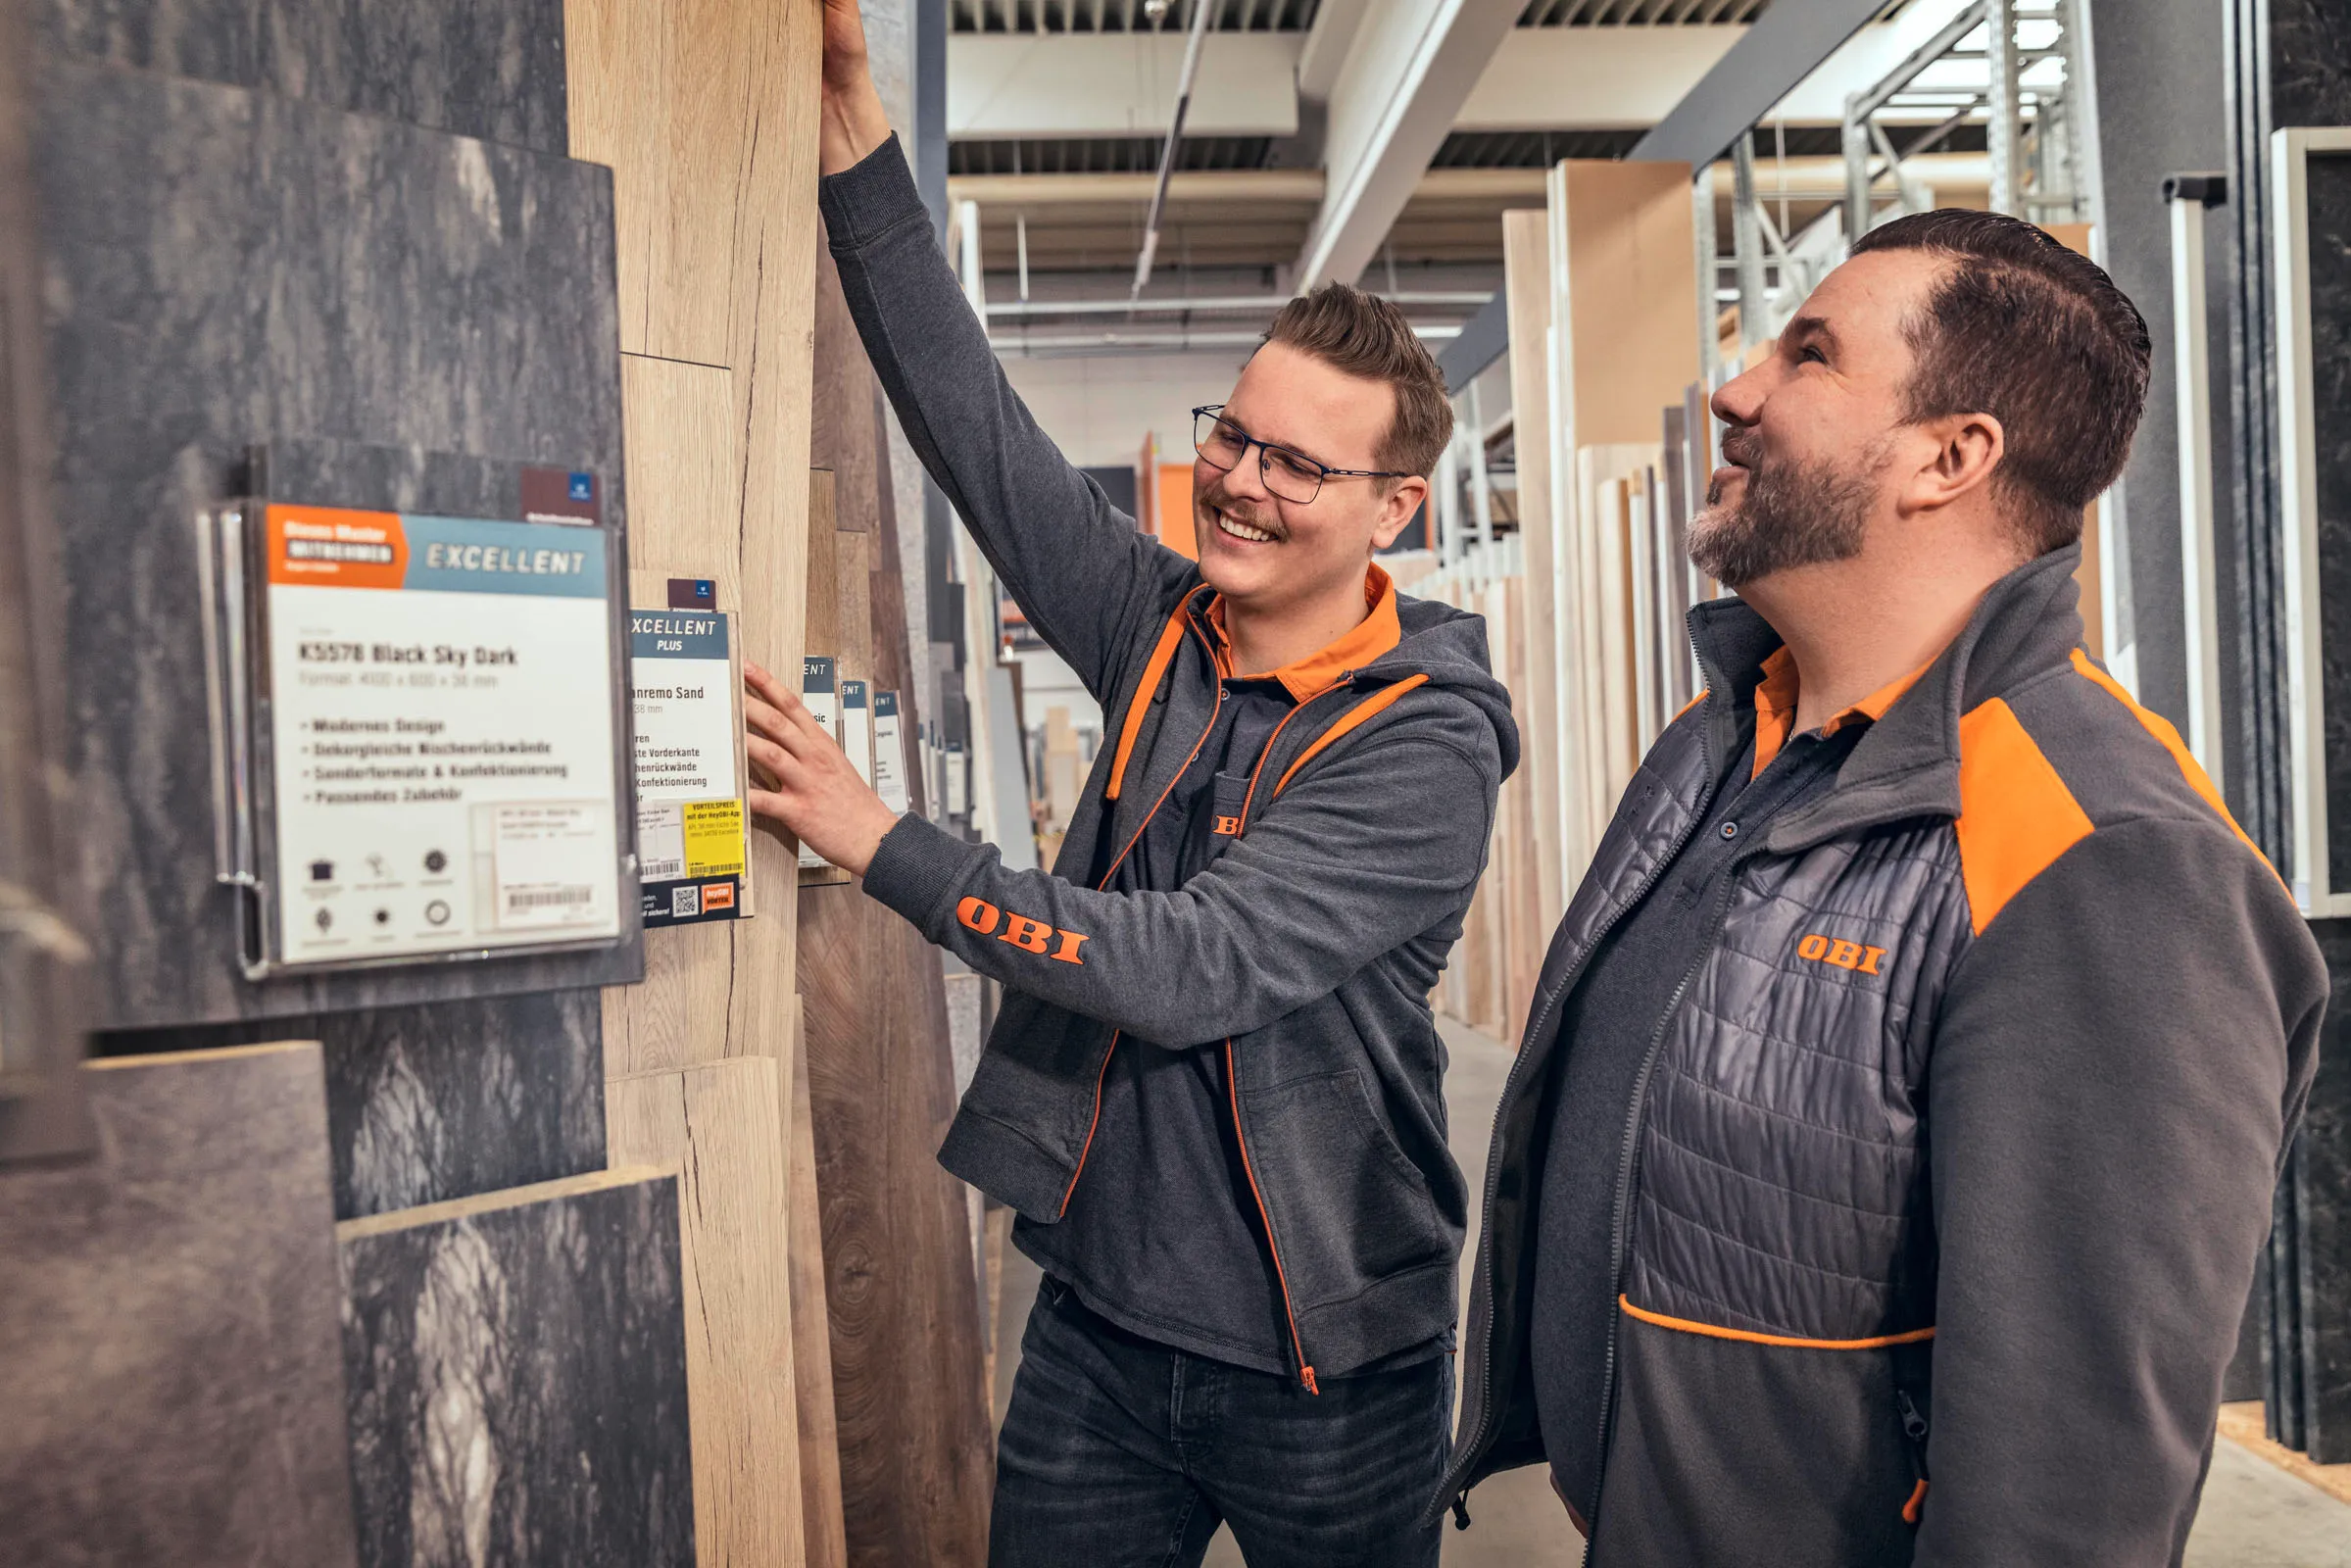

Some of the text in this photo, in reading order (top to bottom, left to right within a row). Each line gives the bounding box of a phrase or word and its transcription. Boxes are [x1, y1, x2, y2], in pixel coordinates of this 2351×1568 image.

[425, 542, 585, 575] EXCELLENT
[631, 617, 716, 635] XCELLENT
[657, 640, 683, 651] PLUS
[372, 643, 425, 664] Black
[434, 644, 467, 667] Sky
[474, 646, 517, 665] Dark
[804, 663, 825, 675] ENT
[631, 686, 704, 699] anremo Sand
[842, 685, 859, 695] ENT
[875, 697, 890, 706] ENT
[813, 713, 826, 723] sic
[313, 718, 444, 736] Modernes Design
[635, 735, 650, 744] ren
[650, 748, 700, 758] Vorderkante
[315, 764, 427, 780] Sonderformate
[450, 762, 567, 779] Konfektionierung
[635, 761, 697, 772] henrückwände
[316, 787, 462, 805] Passendes Zubehör
[956, 896, 1091, 965] OBI
[1797, 934, 1888, 976] OBI
